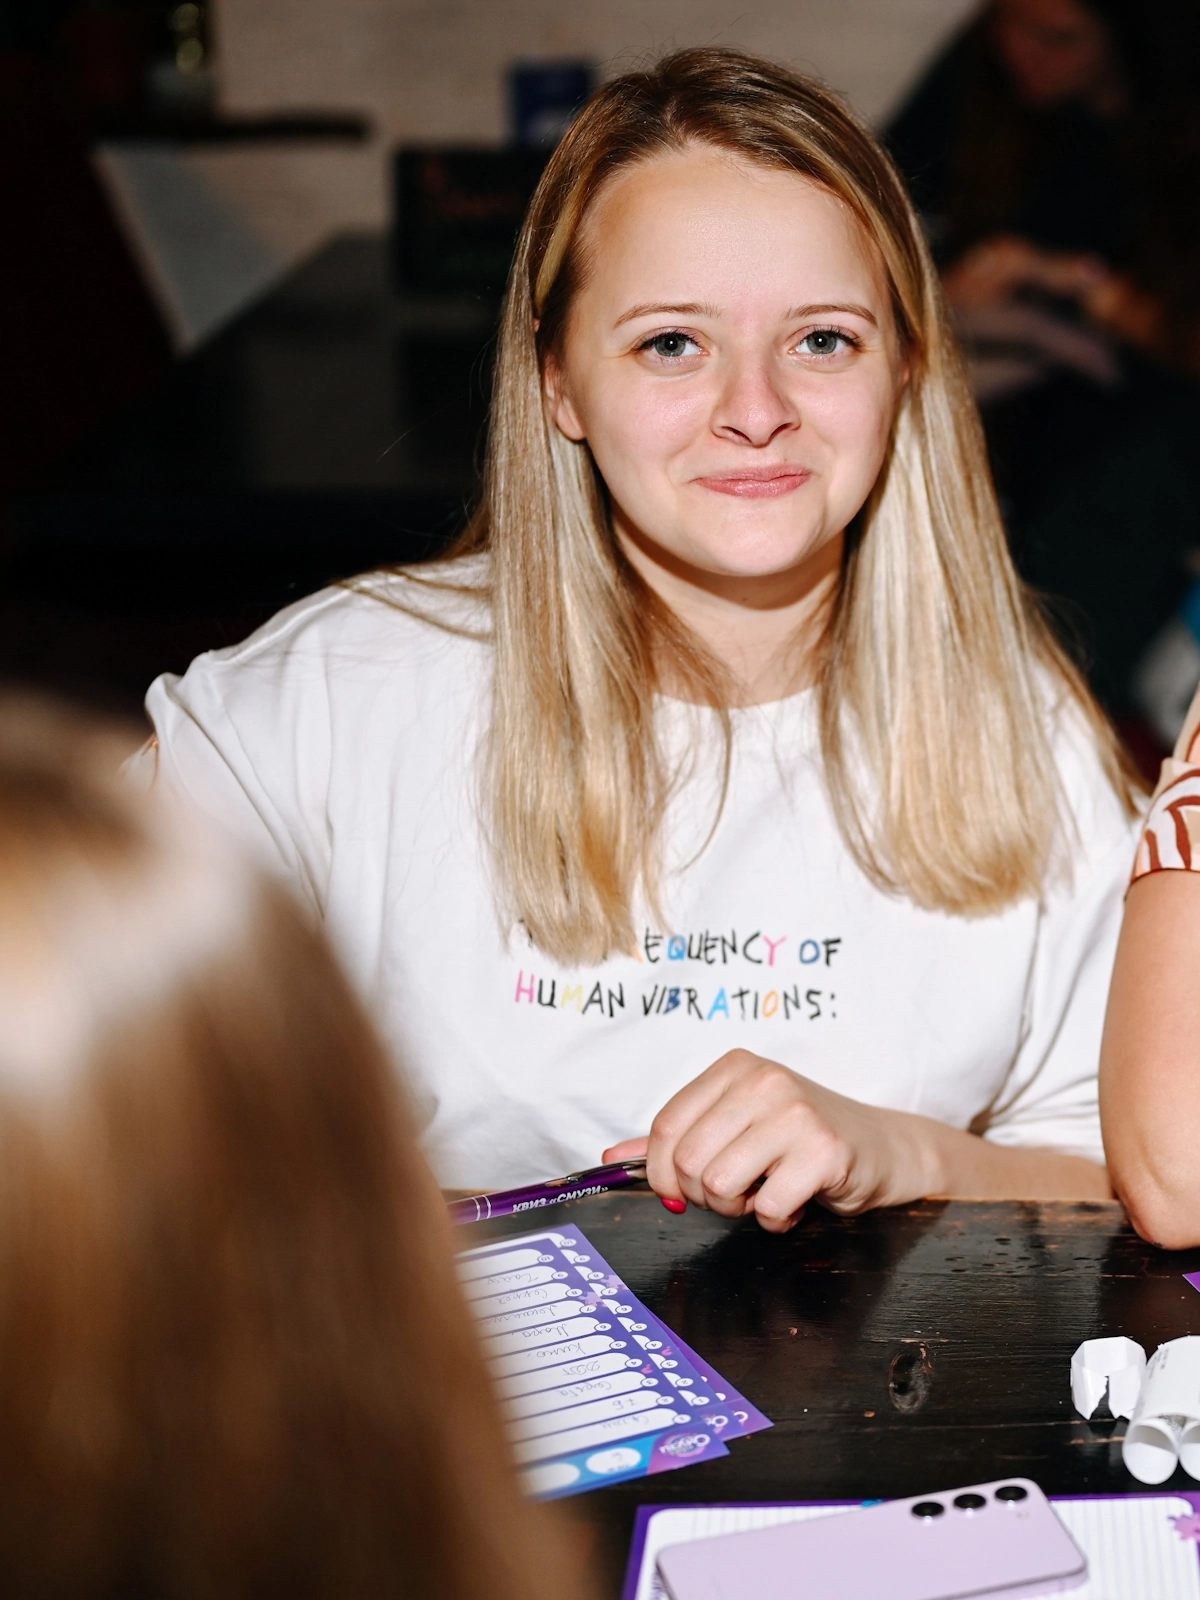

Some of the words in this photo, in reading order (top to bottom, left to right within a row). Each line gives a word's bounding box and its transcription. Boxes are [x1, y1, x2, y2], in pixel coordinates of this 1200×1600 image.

[601, 927, 788, 967] EQUENCY
[798, 937, 843, 967] OF
[514, 969, 626, 1018] HUMAN
[641, 983, 838, 1021] VIBRATIONS:
[512, 1197, 547, 1214] КВИЗ
[549, 1184, 609, 1205] «СМУЗИ»
